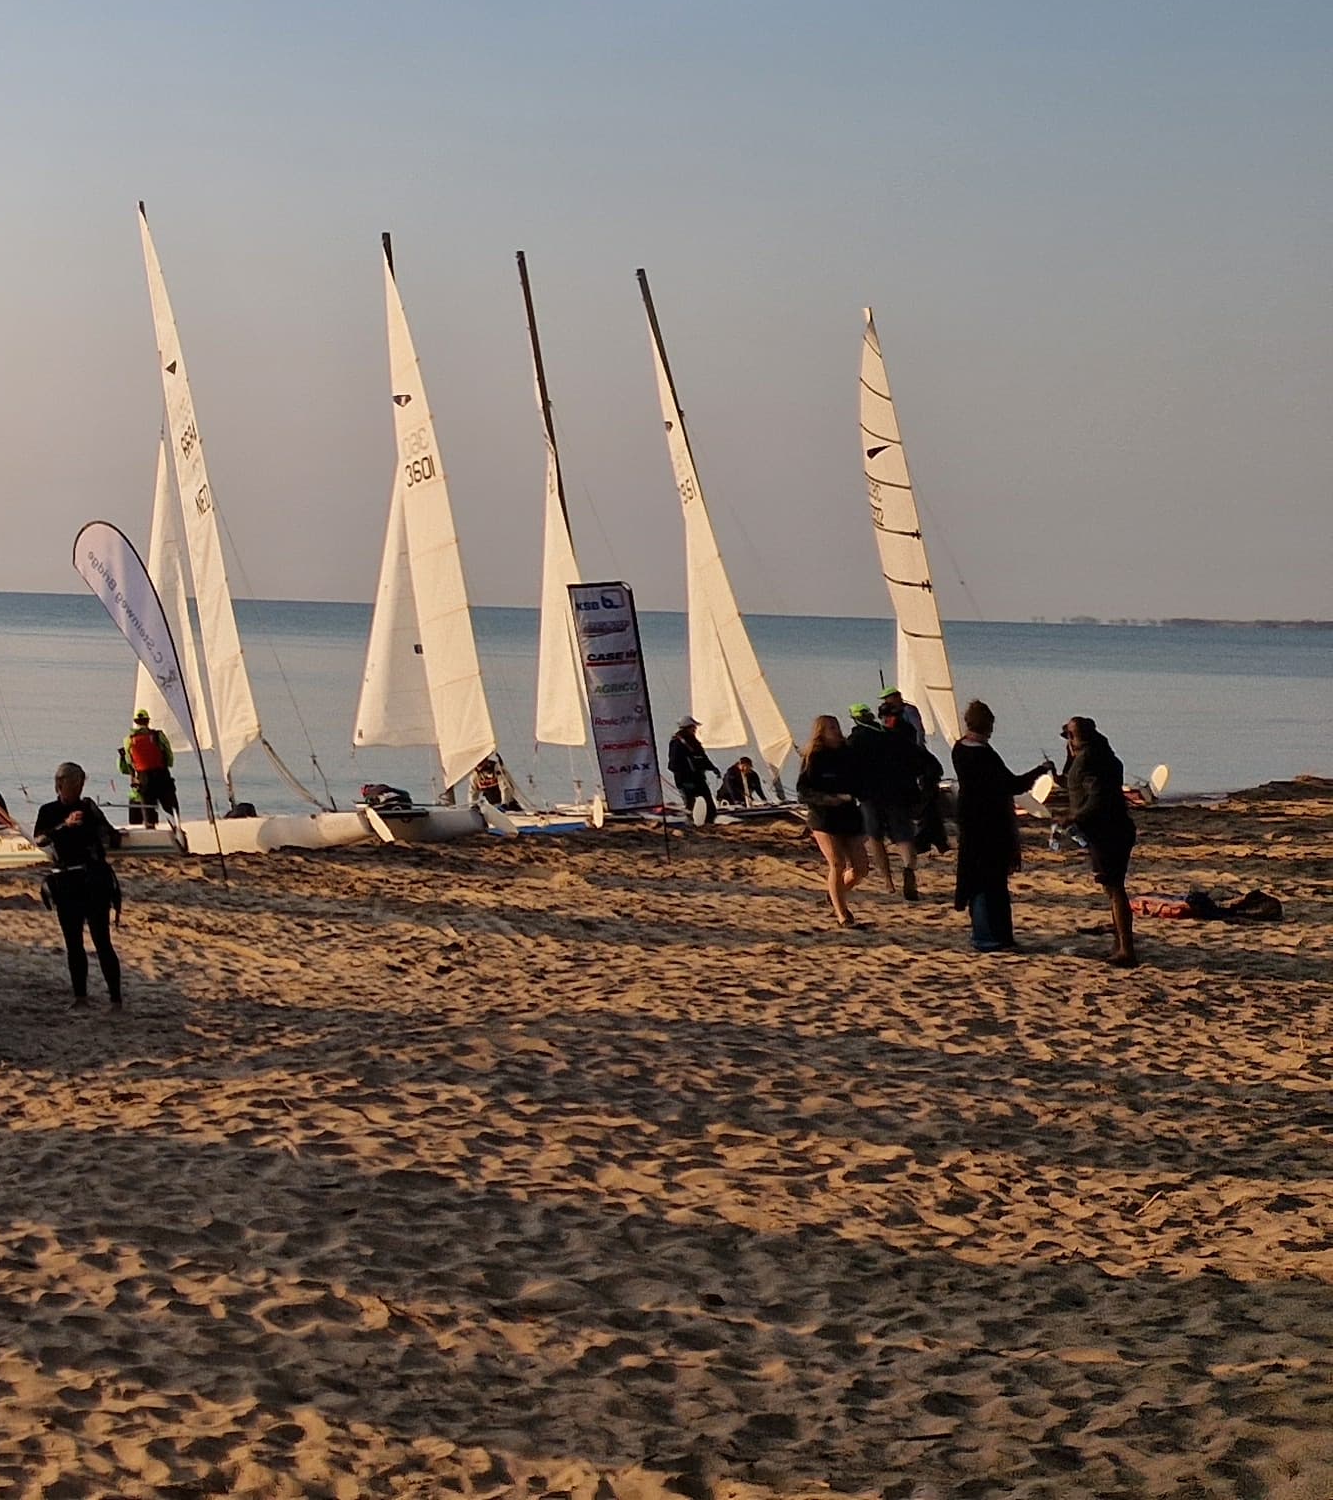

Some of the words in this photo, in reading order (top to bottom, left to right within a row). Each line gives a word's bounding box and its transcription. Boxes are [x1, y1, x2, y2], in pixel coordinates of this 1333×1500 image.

[404, 454, 437, 489] 3601
[587, 651, 625, 662] CASE
[594, 682, 639, 694] AGRICO
[619, 763, 652, 774] AJAX
